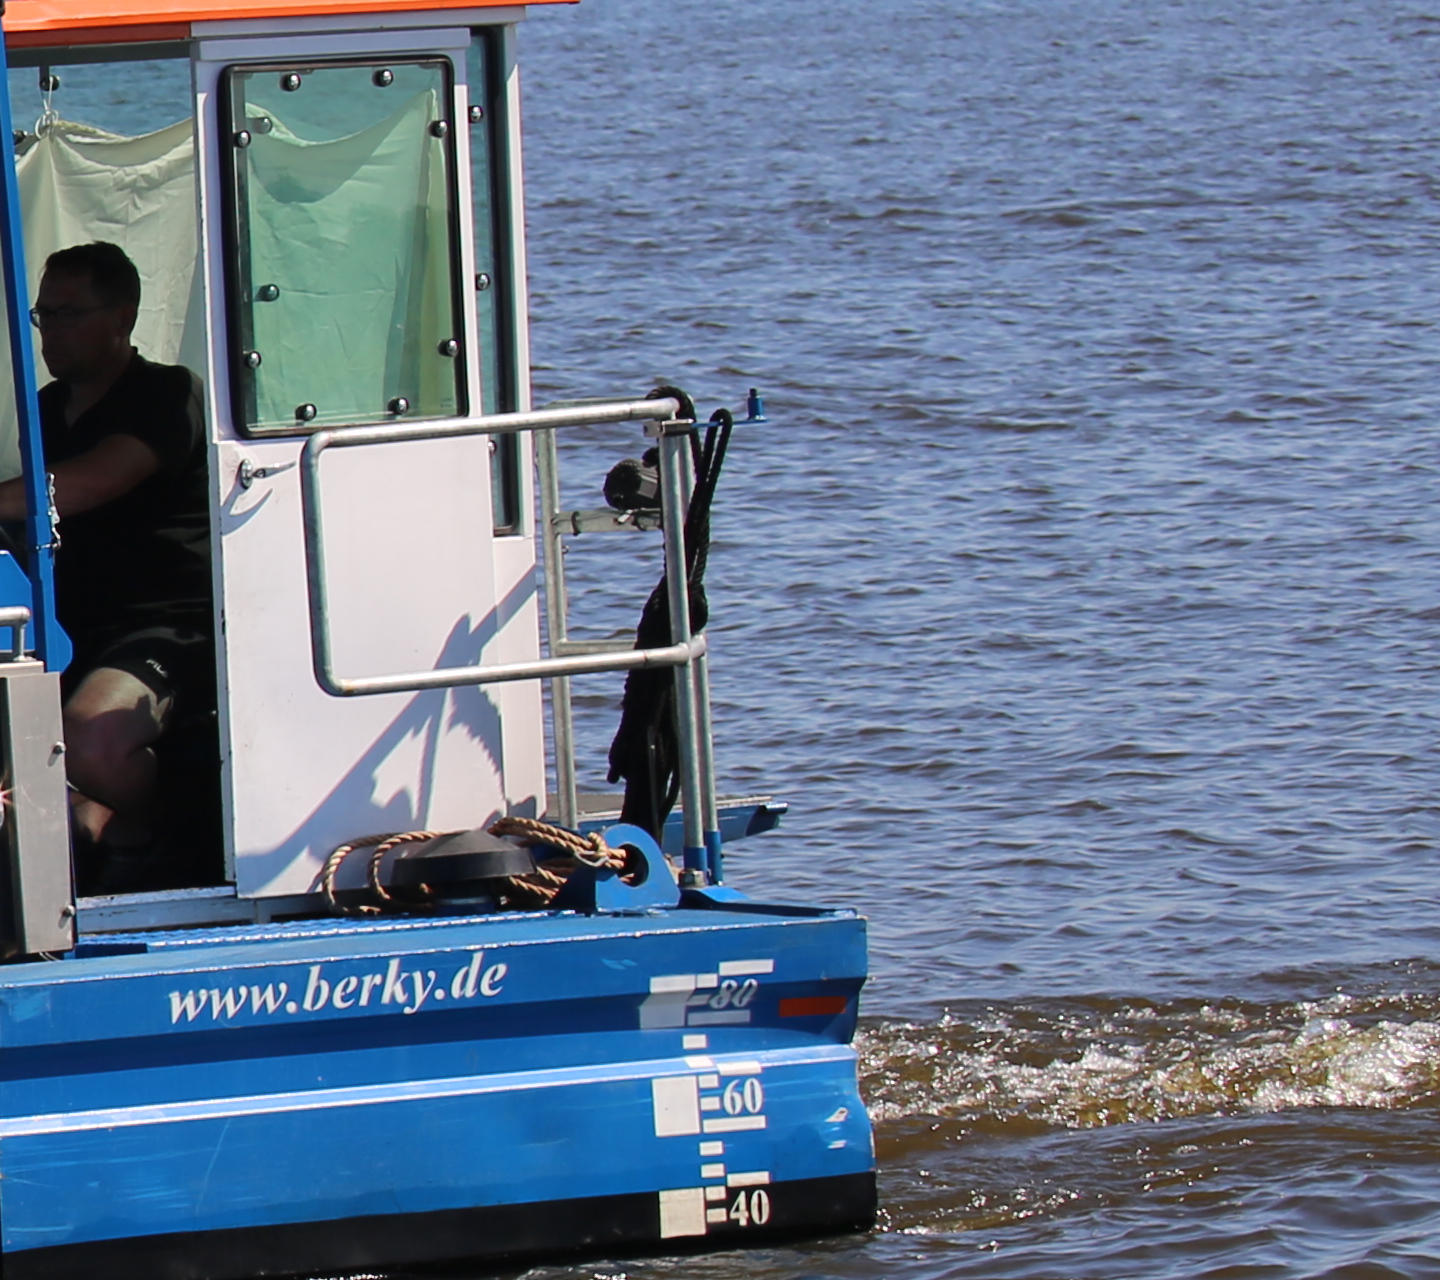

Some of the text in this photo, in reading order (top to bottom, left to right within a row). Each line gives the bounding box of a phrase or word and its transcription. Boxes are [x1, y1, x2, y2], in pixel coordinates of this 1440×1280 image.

[168, 951, 508, 1025] www.berky.de
[709, 978, 758, 1010] 80
[723, 1077, 763, 1116] 60
[729, 1189, 770, 1227] 40
